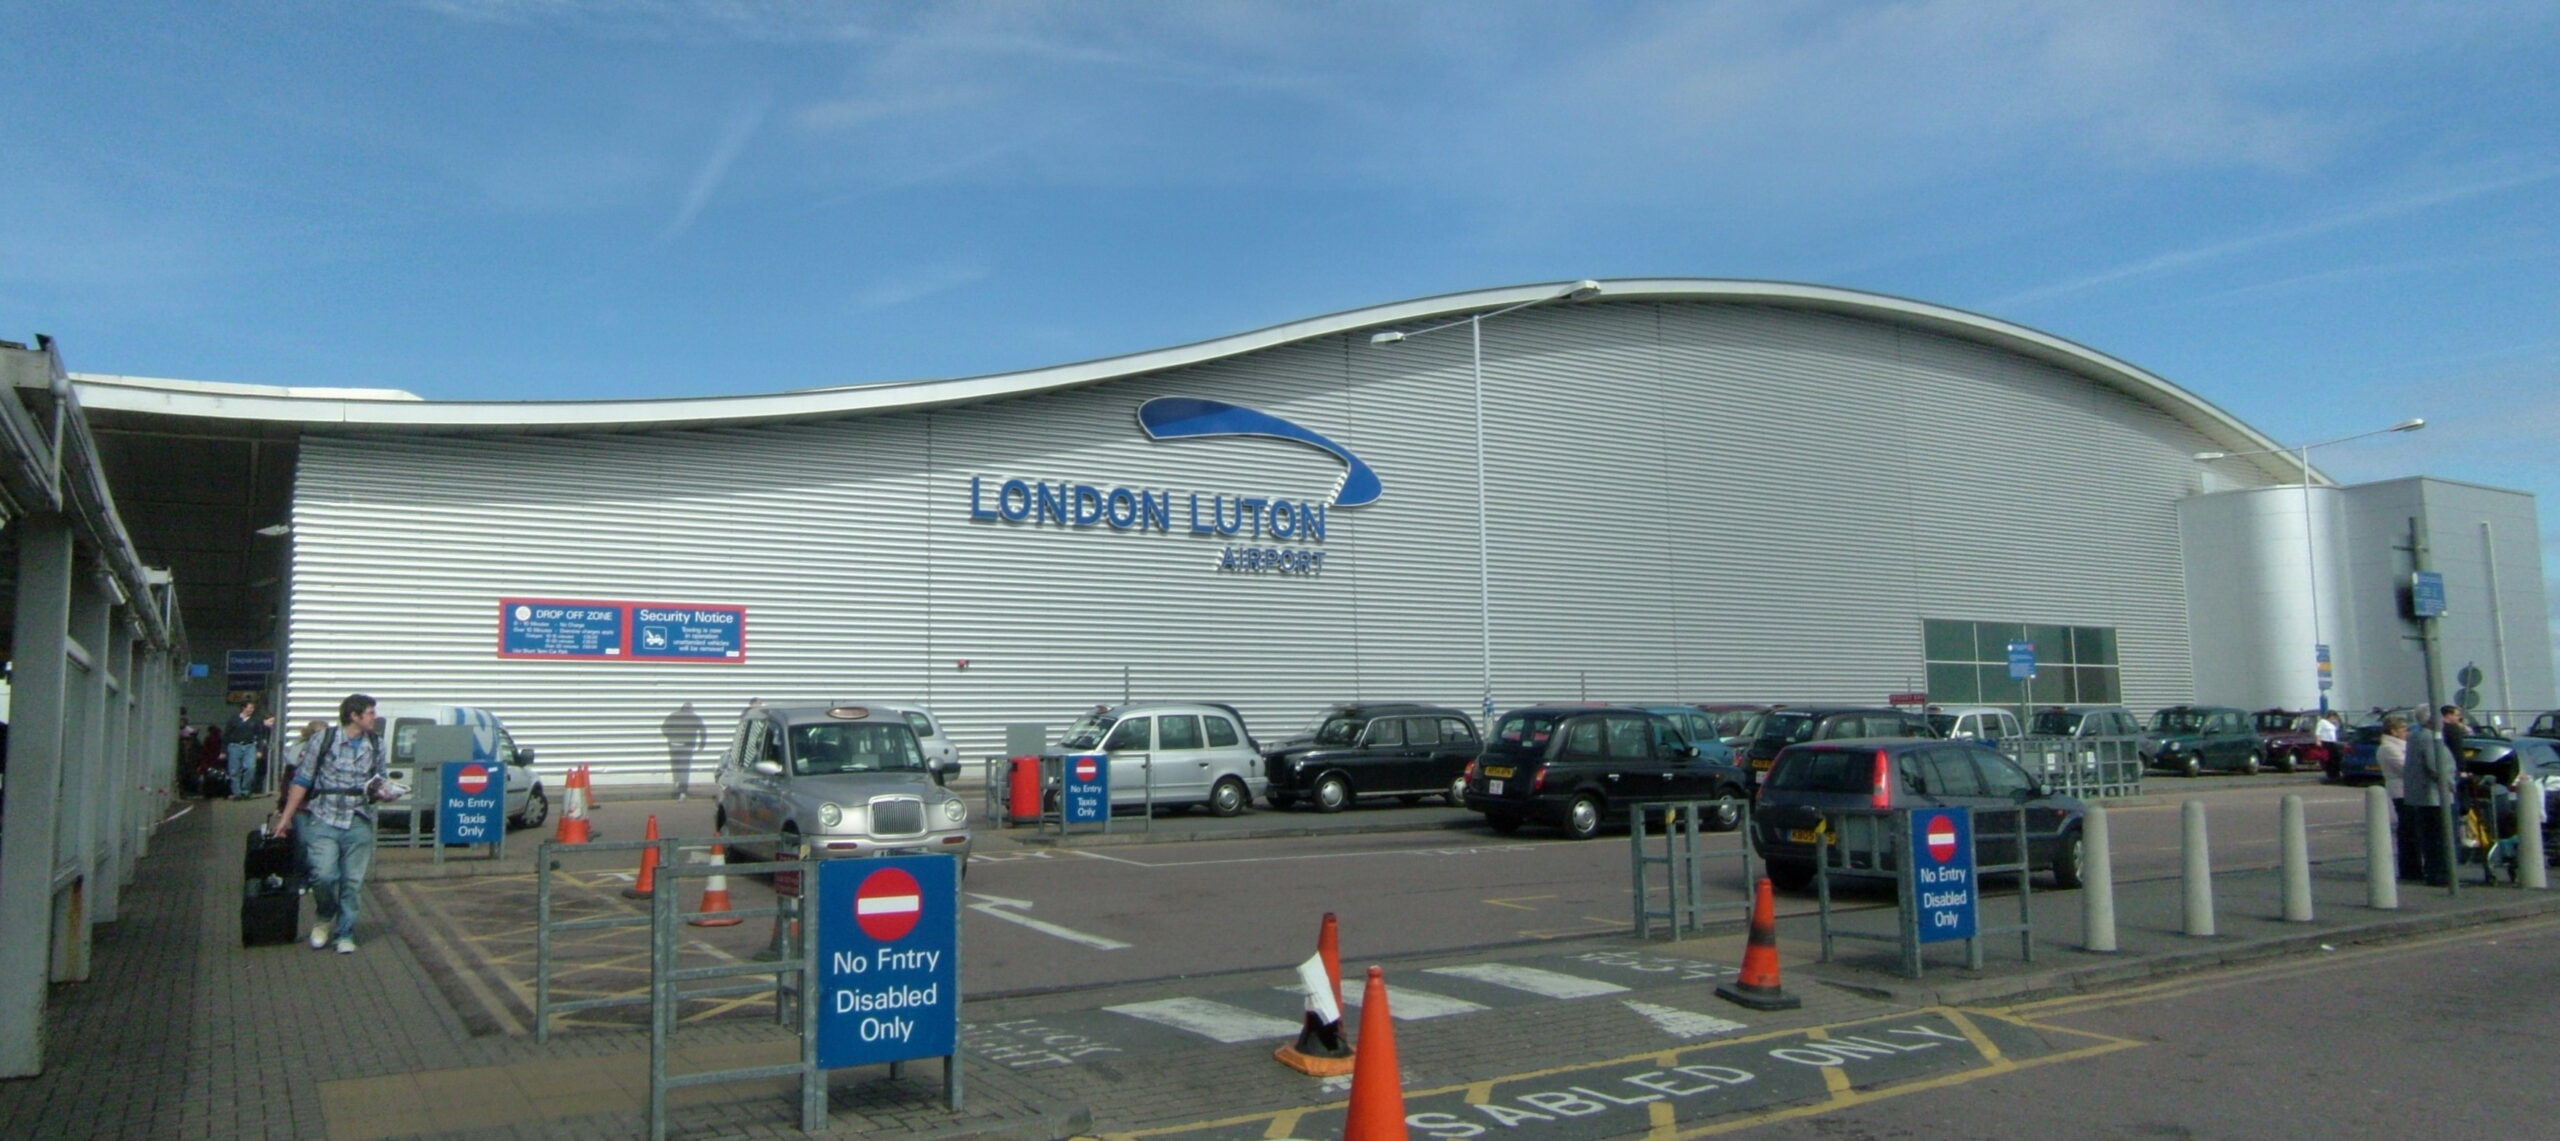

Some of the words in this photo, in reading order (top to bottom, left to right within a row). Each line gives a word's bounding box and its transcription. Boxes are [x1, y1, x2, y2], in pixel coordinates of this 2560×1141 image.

[970, 476, 1171, 532] LONDON
[1190, 493, 1327, 541] LUTON
[1220, 546, 1327, 574] AIRPORT
[536, 609, 563, 619] DROP
[566, 610, 584, 620] OFF
[587, 611, 612, 621] ZONE
[640, 609, 691, 624] Security
[695, 611, 734, 623] Notice
[1070, 785, 1081, 793] No
[1083, 784, 1102, 794] Entry
[448, 799, 464, 808] No
[467, 798, 496, 809] Entry
[1077, 797, 1097, 806] Taxis
[457, 813, 486, 824] Taxis
[1077, 808, 1096, 818] Only
[458, 826, 485, 838] Only
[1921, 868, 1936, 883] No
[1939, 866, 1966, 884] Entry
[1924, 890, 1967, 909] Disabled
[1935, 911, 1958, 929] Only
[833, 952, 868, 975] No
[836, 982, 938, 1014] Disabled
[860, 1016, 914, 1043] Only
[1404, 1065, 1755, 1137] SABLED
[1768, 1025, 1967, 1067] ONLY
